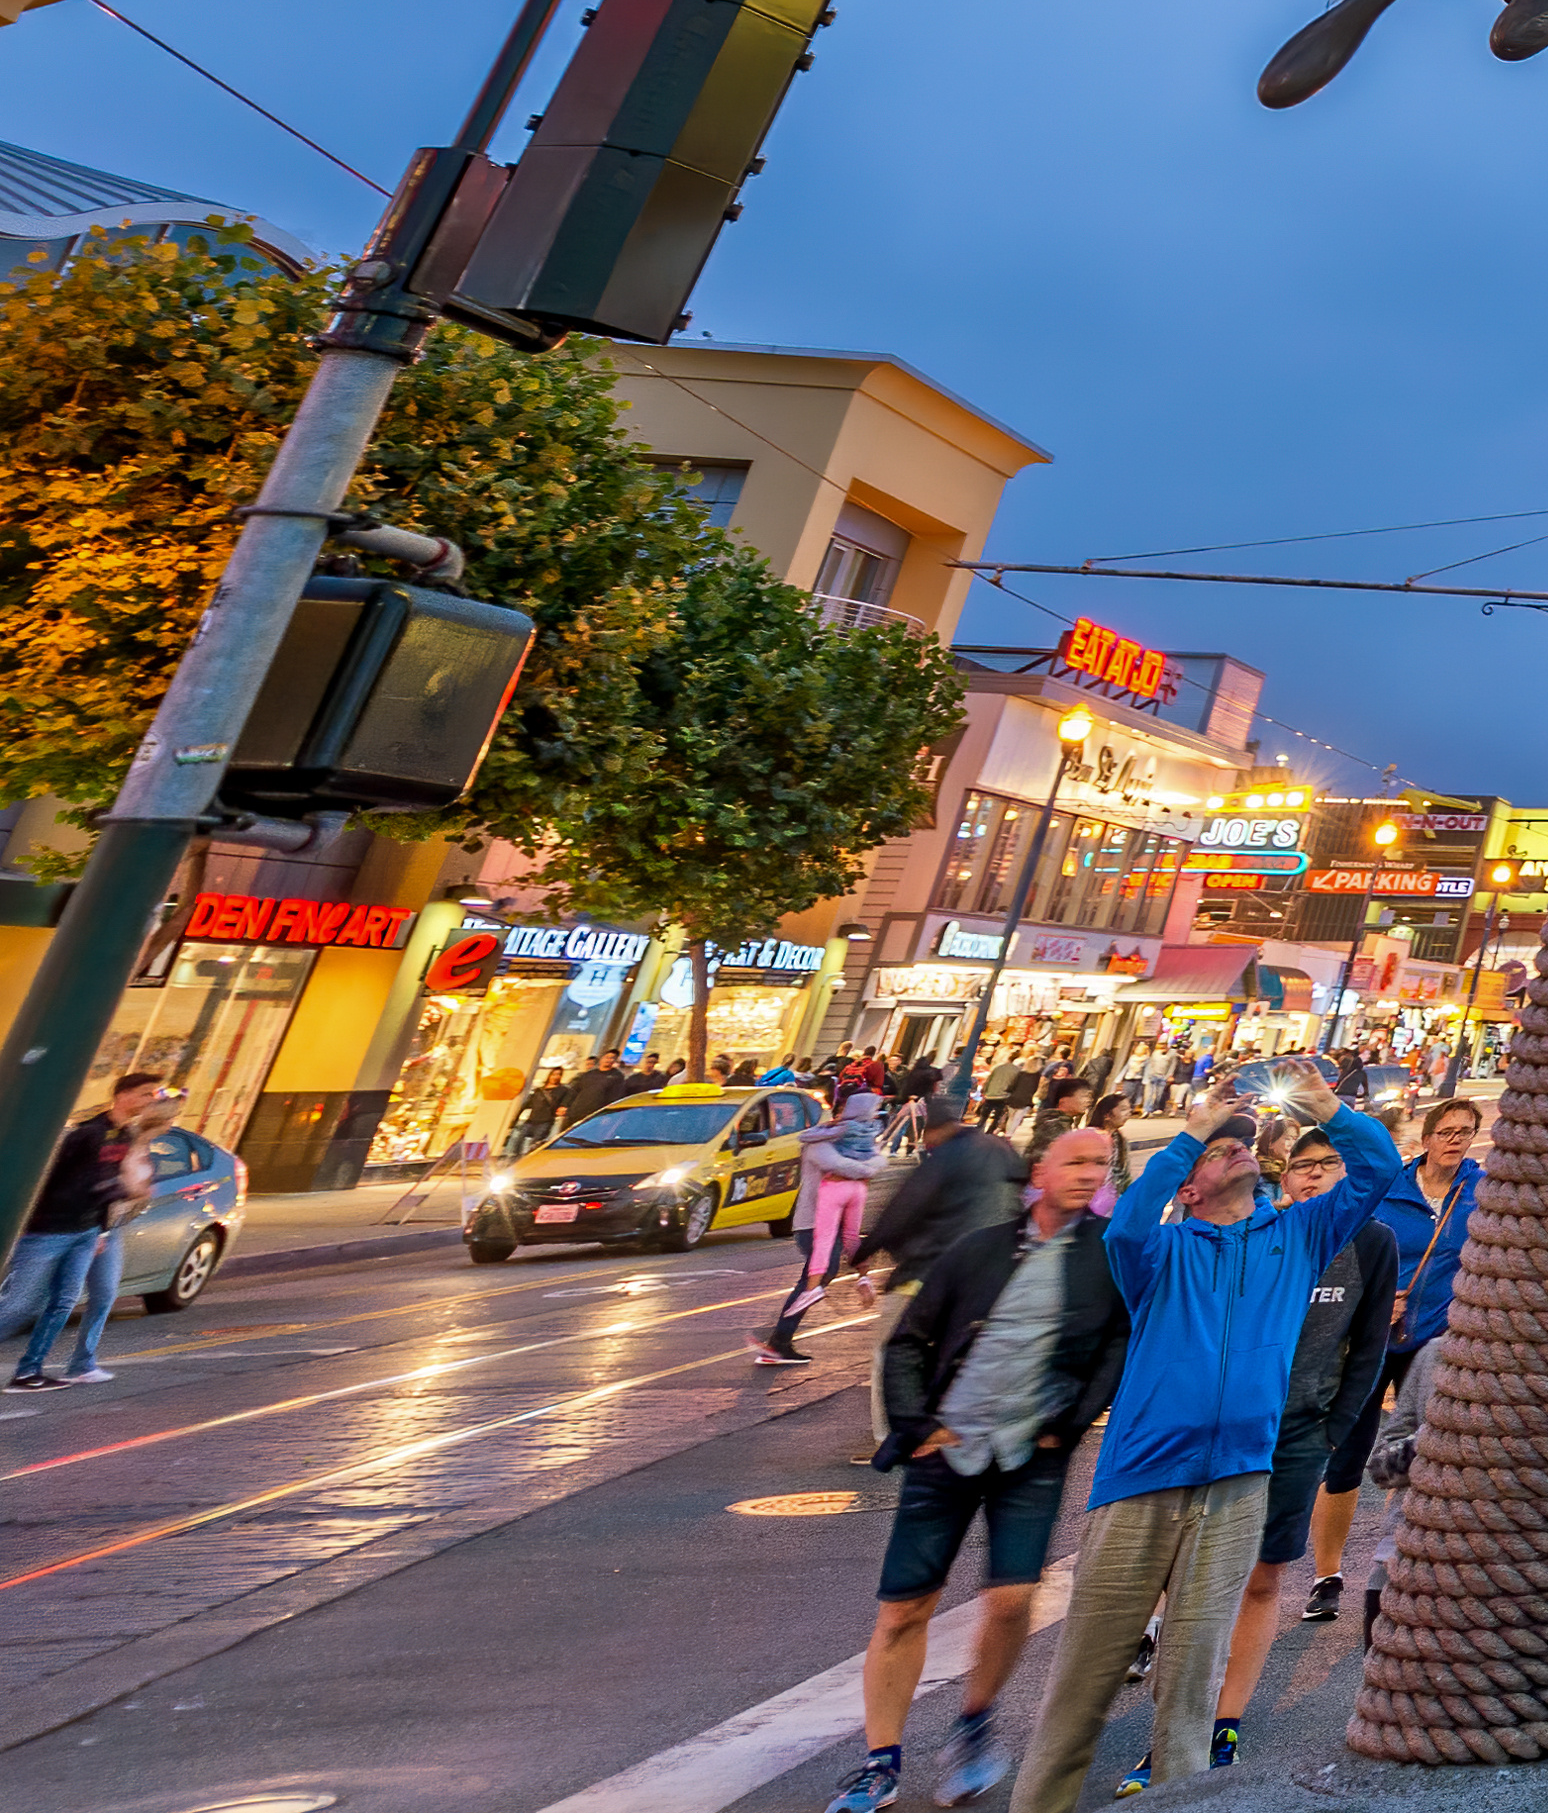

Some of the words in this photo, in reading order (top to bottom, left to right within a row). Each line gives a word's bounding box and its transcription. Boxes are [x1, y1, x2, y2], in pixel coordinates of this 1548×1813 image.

[1065, 617, 1118, 677] EAT
[1200, 818, 1300, 847] JOE'S
[1334, 871, 1434, 891] PARKING
[184, 892, 272, 940] DEN
[336, 904, 412, 947] ART
[565, 923, 651, 963] GALLERY
